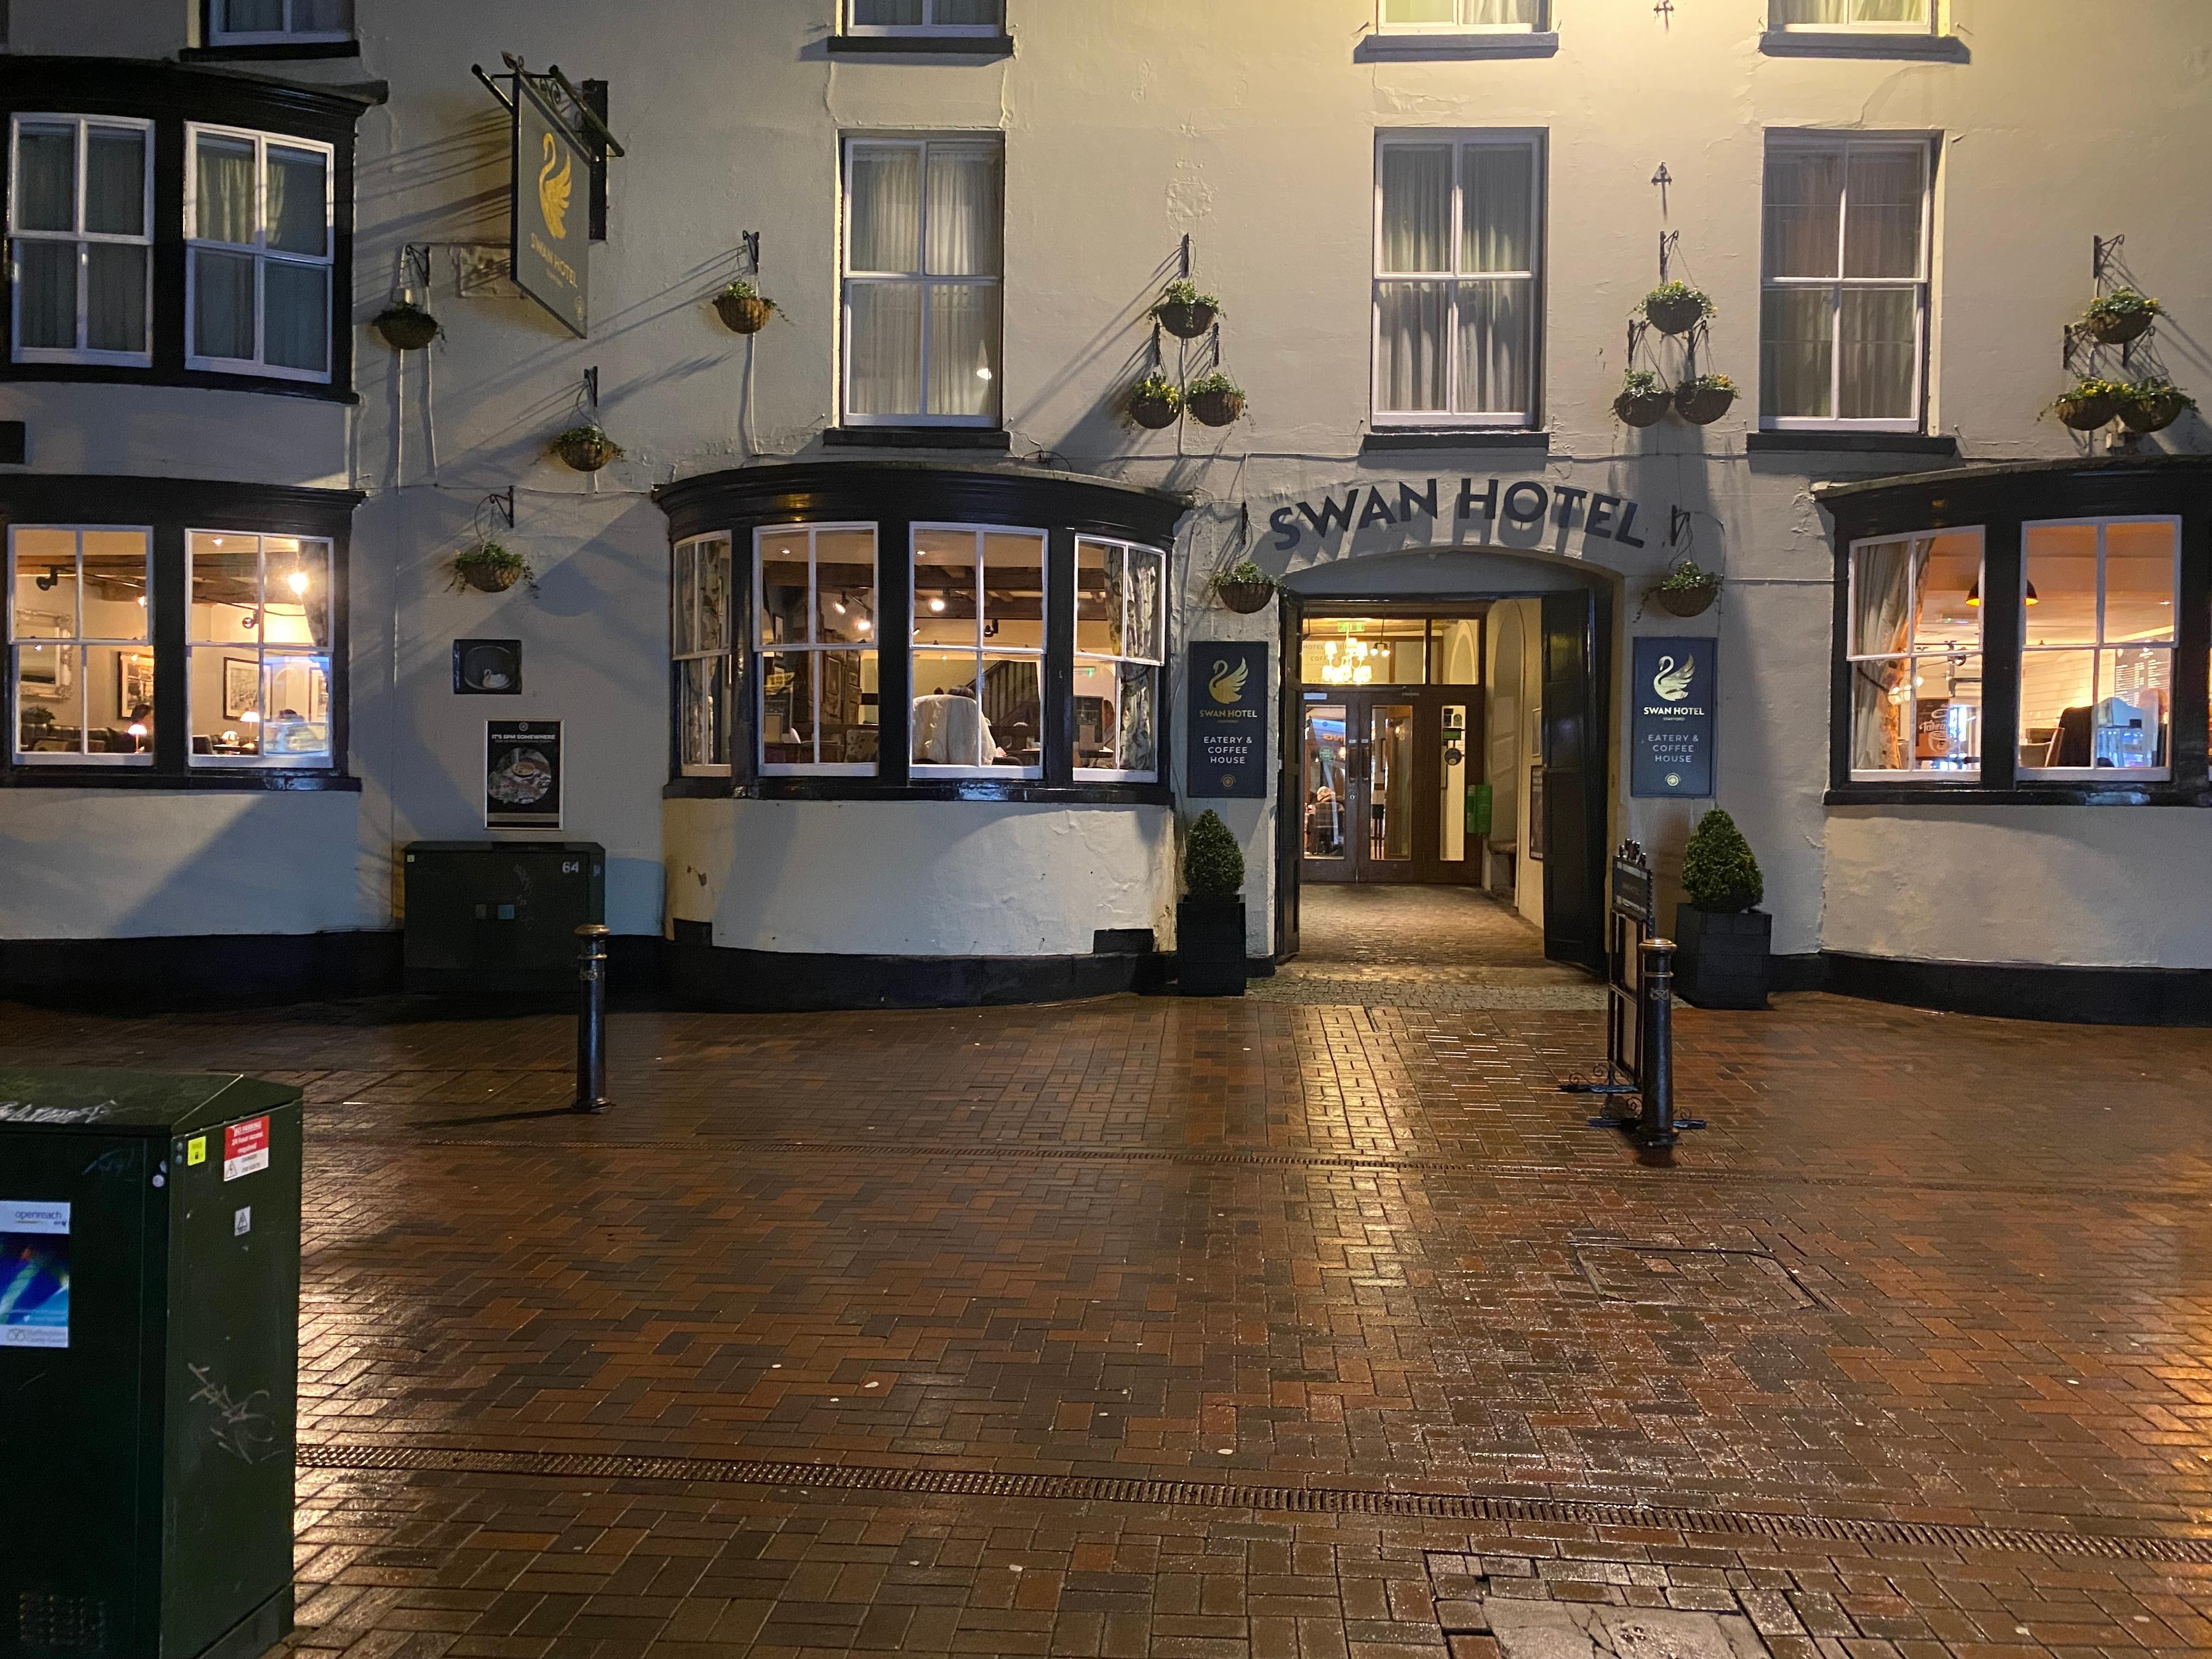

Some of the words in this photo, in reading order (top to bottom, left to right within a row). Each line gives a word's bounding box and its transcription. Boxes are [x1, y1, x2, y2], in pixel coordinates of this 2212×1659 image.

[531, 233, 553, 265] SWAN
[554, 253, 578, 288] HOTEL
[1269, 478, 1438, 550] SWAN
[1458, 478, 1645, 548] HOTEL
[1199, 709, 1226, 718] SWAN
[1228, 709, 1257, 718] HOTEL
[1643, 707, 1672, 715] SWAN
[1673, 707, 1705, 715] HOTEL
[562, 861, 579, 873] 64
[15, 1211, 61, 1220] openreach
